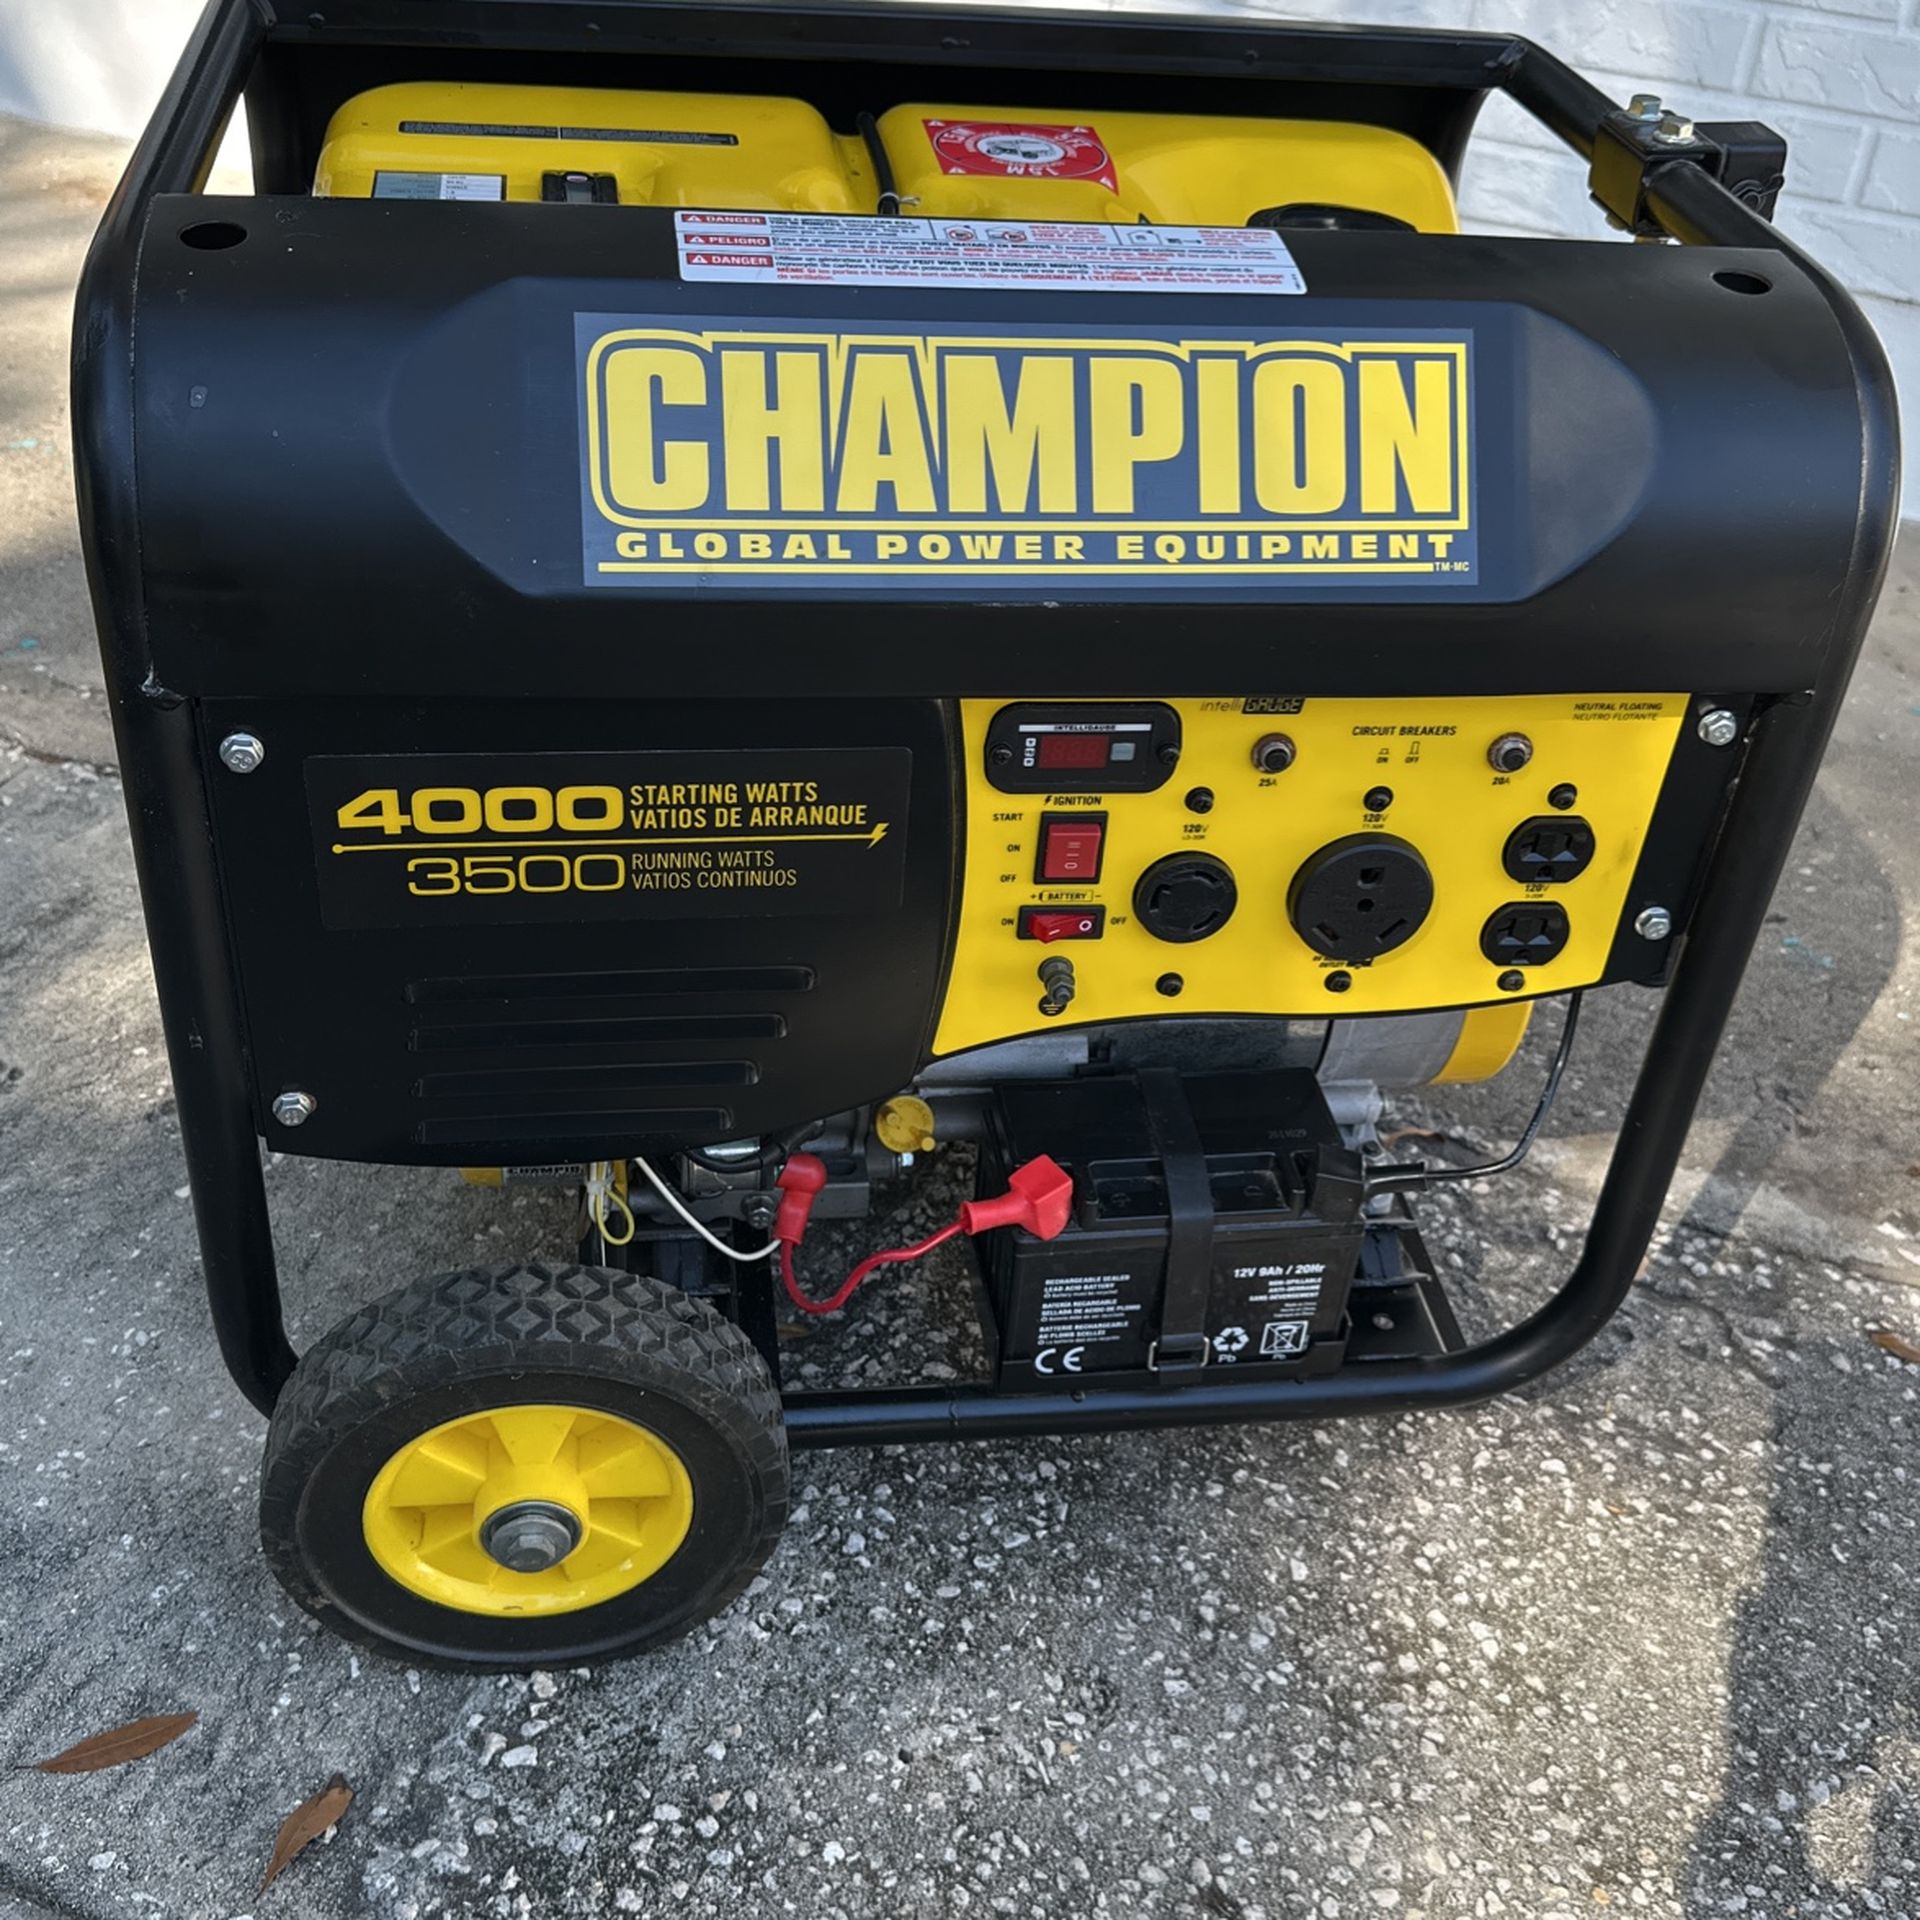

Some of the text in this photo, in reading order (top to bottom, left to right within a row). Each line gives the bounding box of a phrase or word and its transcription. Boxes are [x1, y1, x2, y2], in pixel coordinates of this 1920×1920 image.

[705, 216, 761, 224] DANGER
[708, 237, 768, 246] PELIGRO
[711, 255, 769, 266] DANGER
[604, 346, 1452, 515] CHAMPION
[615, 532, 1454, 563] GLOBAL POWER EQUIPMENT
[1573, 702, 1664, 711] NEUTRAL FLOATING
[1572, 712, 1659, 721] NEUTRO FLOTANTE
[1351, 725, 1458, 736] CIRCUIT BREAKERS
[1404, 756, 1420, 764] OFF
[1258, 778, 1277, 787] 25A
[1491, 777, 1510, 786] 20A
[630, 782, 819, 806] STARTING WATTS
[1053, 795, 1103, 806] IGNITION
[336, 785, 624, 835] 4000
[630, 804, 868, 830] VATIOS DE ARRANQUE
[993, 812, 1024, 822] START
[1362, 813, 1390, 823] 120V
[1183, 823, 1210, 834] 120V
[1007, 844, 1021, 852] ON
[631, 849, 775, 871] RUNNING WATTS
[407, 853, 626, 896] 3500
[631, 868, 798, 891] VATIOS CONTINUOS
[1000, 874, 1017, 883] OFF
[1048, 892, 1088, 900] BATTERY
[1001, 916, 1127, 926] ON OFF
[1233, 1266, 1257, 1278] 12V
[1258, 1264, 1283, 1277] 9Ah
[1294, 1262, 1327, 1275] 20Hr
[1045, 1276, 1101, 1285] RECHARGEABLE
[1044, 1282, 1115, 1293] LEAD ACID BATTERY
[1218, 1353, 1237, 1363] Pb
